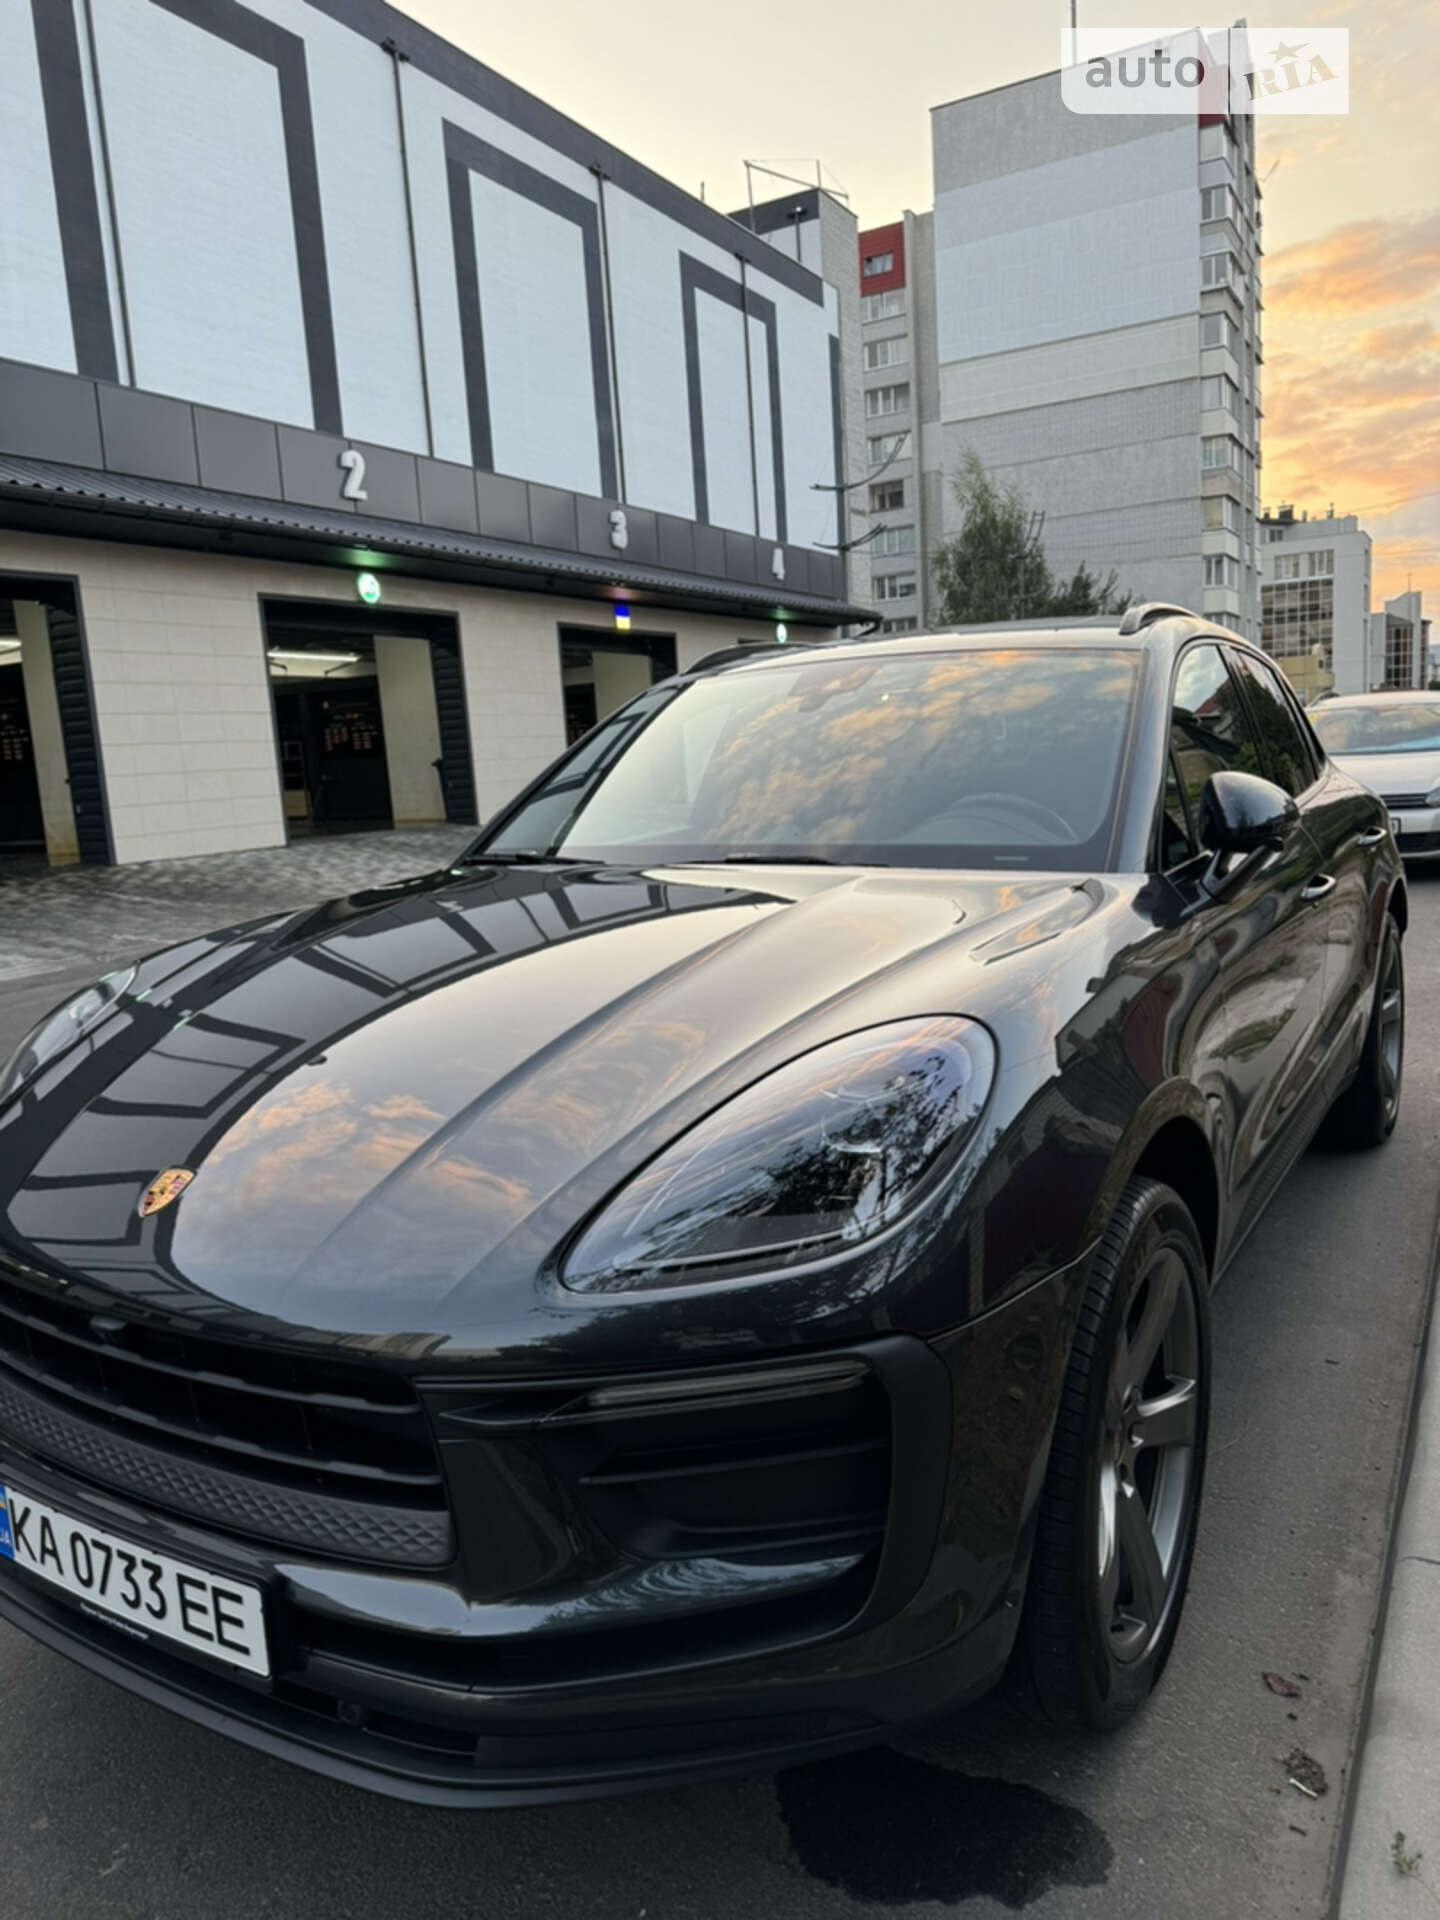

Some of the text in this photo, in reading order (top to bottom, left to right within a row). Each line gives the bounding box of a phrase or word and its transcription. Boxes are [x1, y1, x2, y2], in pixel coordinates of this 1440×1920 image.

[339, 450, 368, 500] 2
[610, 510, 628, 549] 3
[772, 547, 785, 580] 4
[9, 1498, 64, 1576] KA
[70, 1531, 167, 1620] 0733
[176, 1573, 251, 1656] EE
